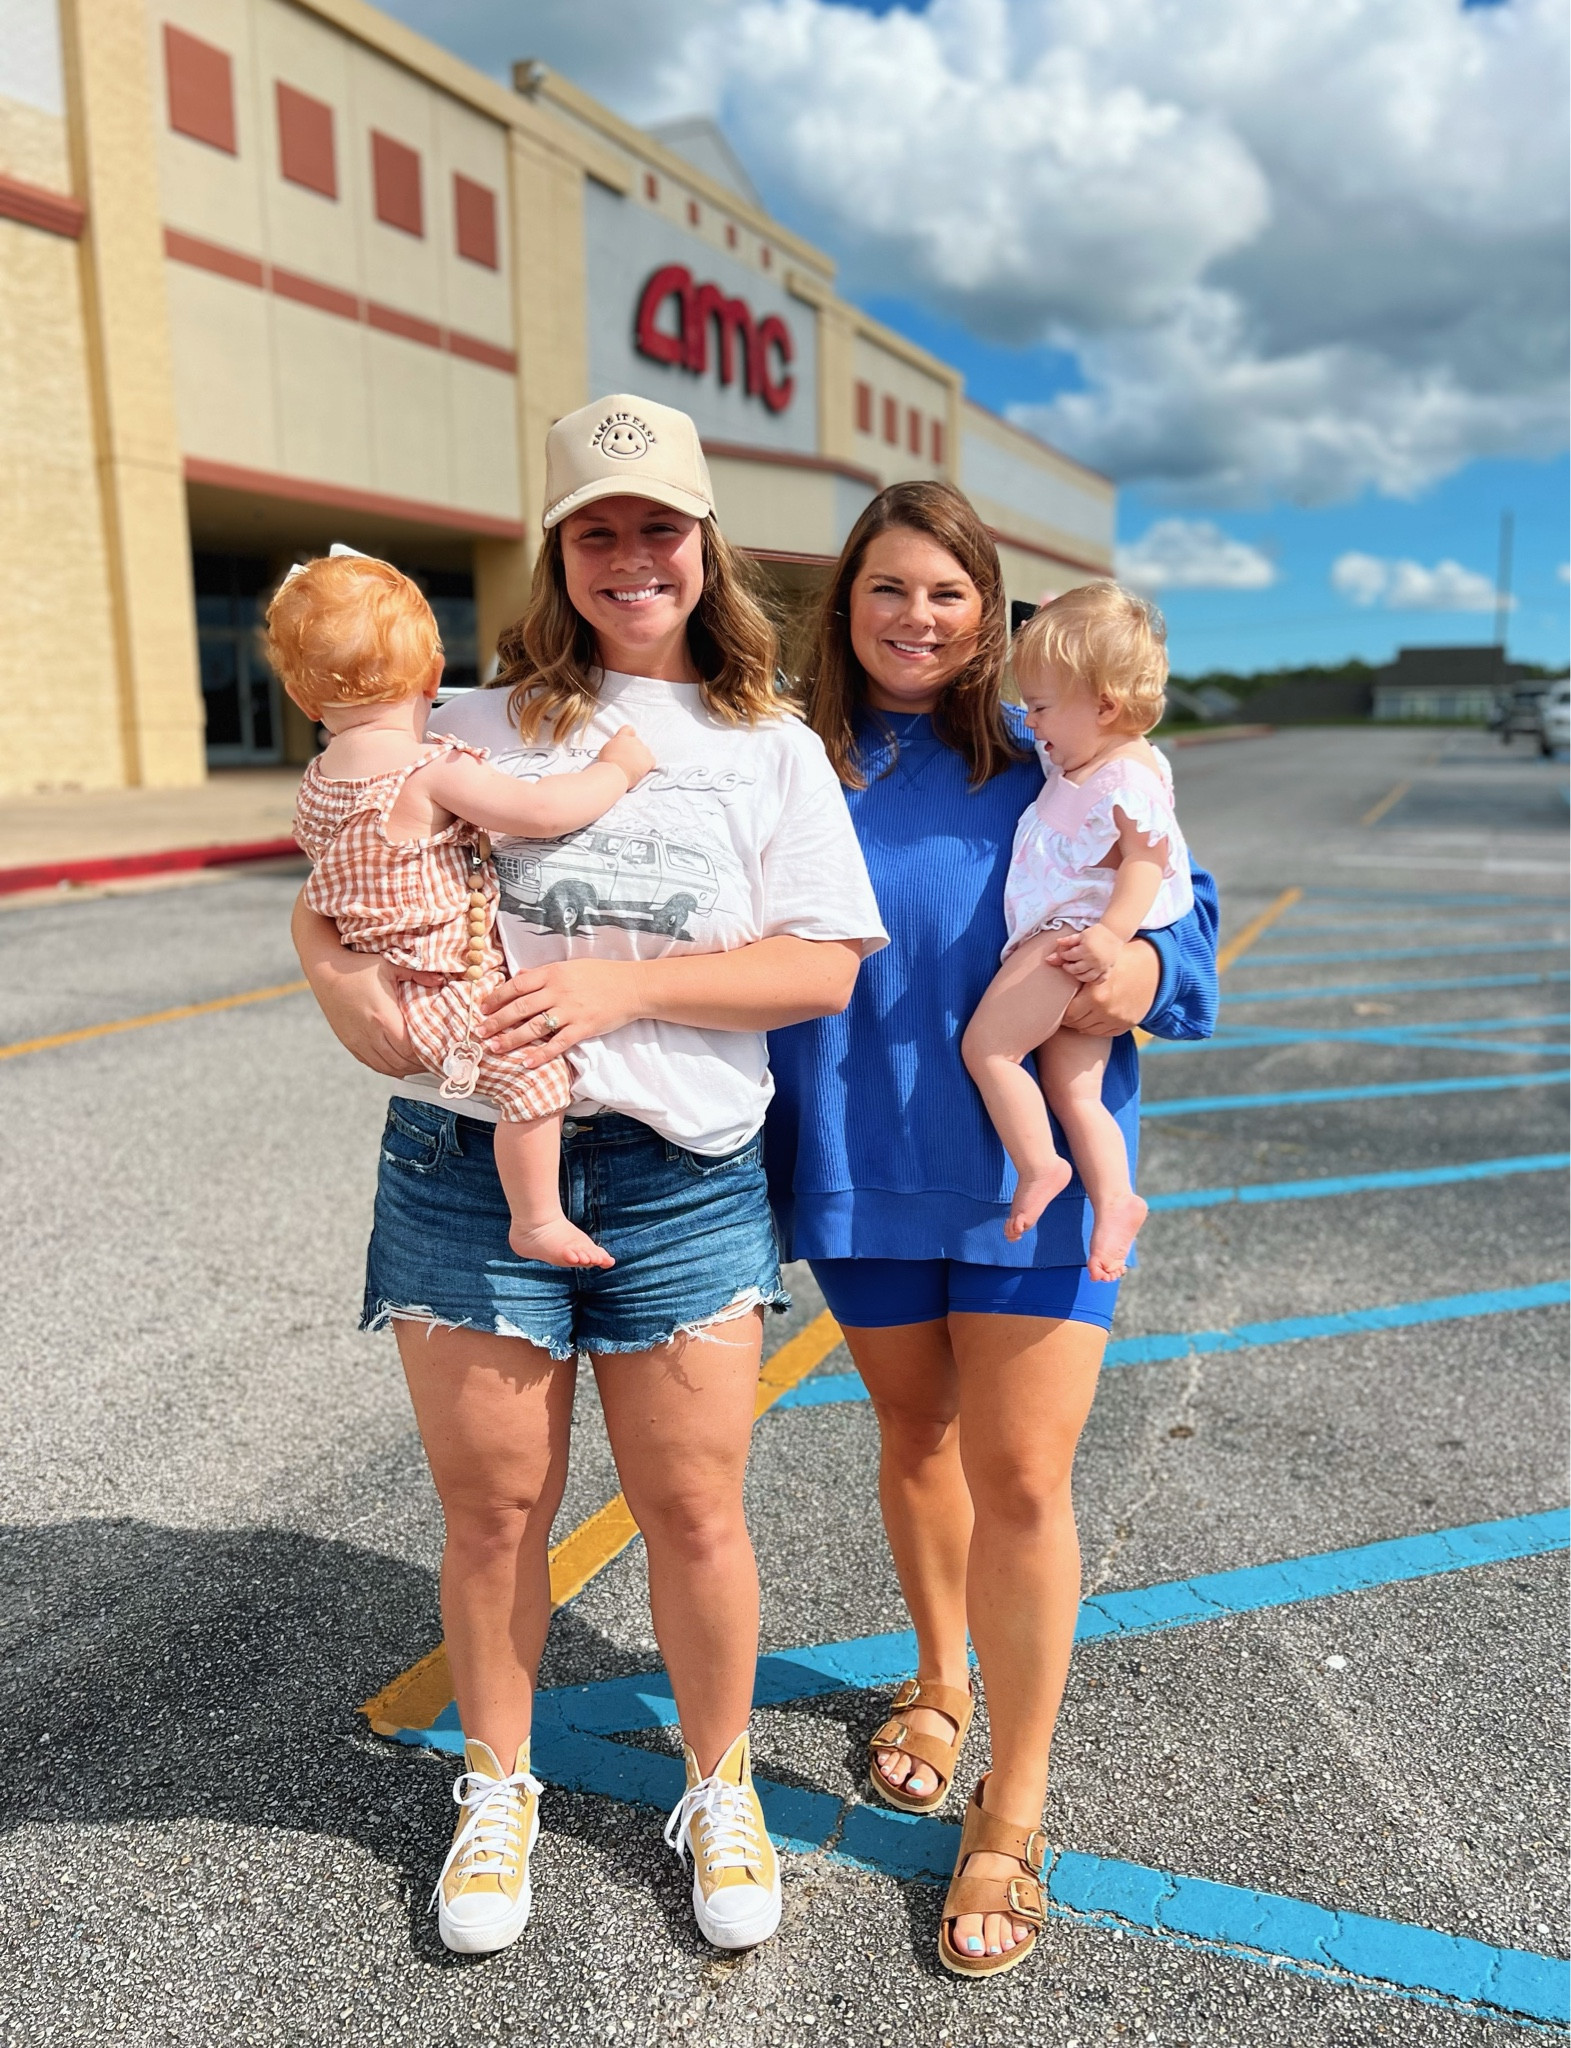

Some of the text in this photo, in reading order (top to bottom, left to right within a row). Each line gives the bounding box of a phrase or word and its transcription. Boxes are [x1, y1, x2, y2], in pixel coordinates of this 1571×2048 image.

[592, 413, 656, 446] TAKE IT EASY
